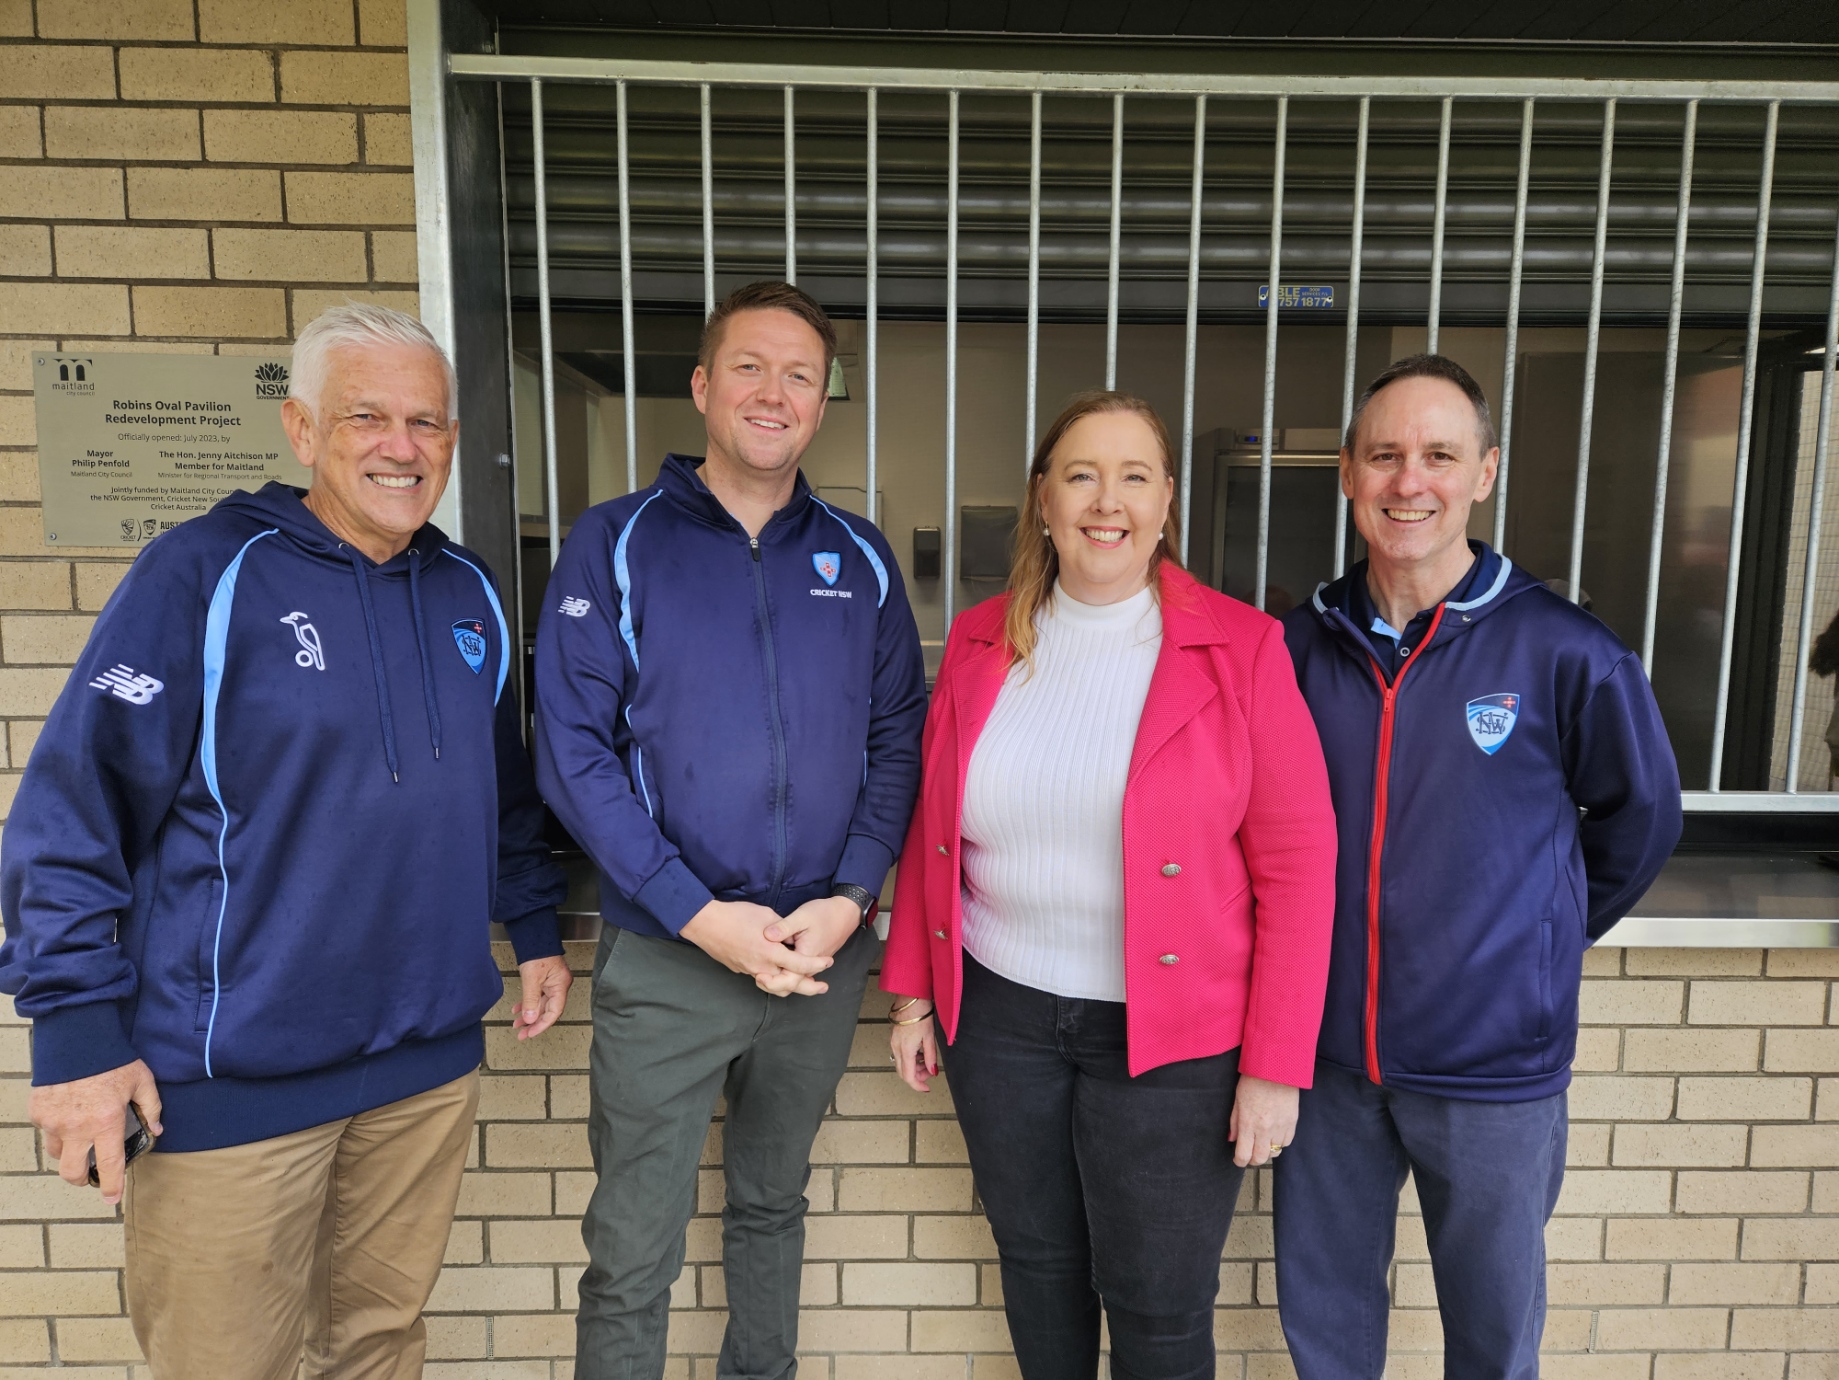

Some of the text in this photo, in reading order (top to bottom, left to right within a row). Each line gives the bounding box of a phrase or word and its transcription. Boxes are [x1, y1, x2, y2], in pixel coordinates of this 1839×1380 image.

[1266, 287, 1300, 297] BLE
[1301, 297, 1327, 307] 1877
[52, 382, 95, 391] maitland
[256, 383, 289, 396] NSW
[113, 400, 232, 412] Robins Oval Pavilion
[105, 413, 241, 429] Redevelopment Project
[118, 433, 231, 444] Officially opened: July 2023, by
[86, 450, 114, 459] Mayor
[159, 451, 175, 459] The
[176, 451, 197, 460] Hon.
[198, 452, 222, 461] Jenny
[223, 452, 263, 460] Aitchison
[72, 459, 130, 469] Philip Penfold
[226, 463, 264, 471] Maitland
[111, 486, 133, 494] Jointly
[134, 486, 159, 494] funded
[160, 487, 169, 495] by
[201, 488, 215, 496] City
[150, 503, 175, 511] Cricket
[810, 589, 838, 597] CRICKET
